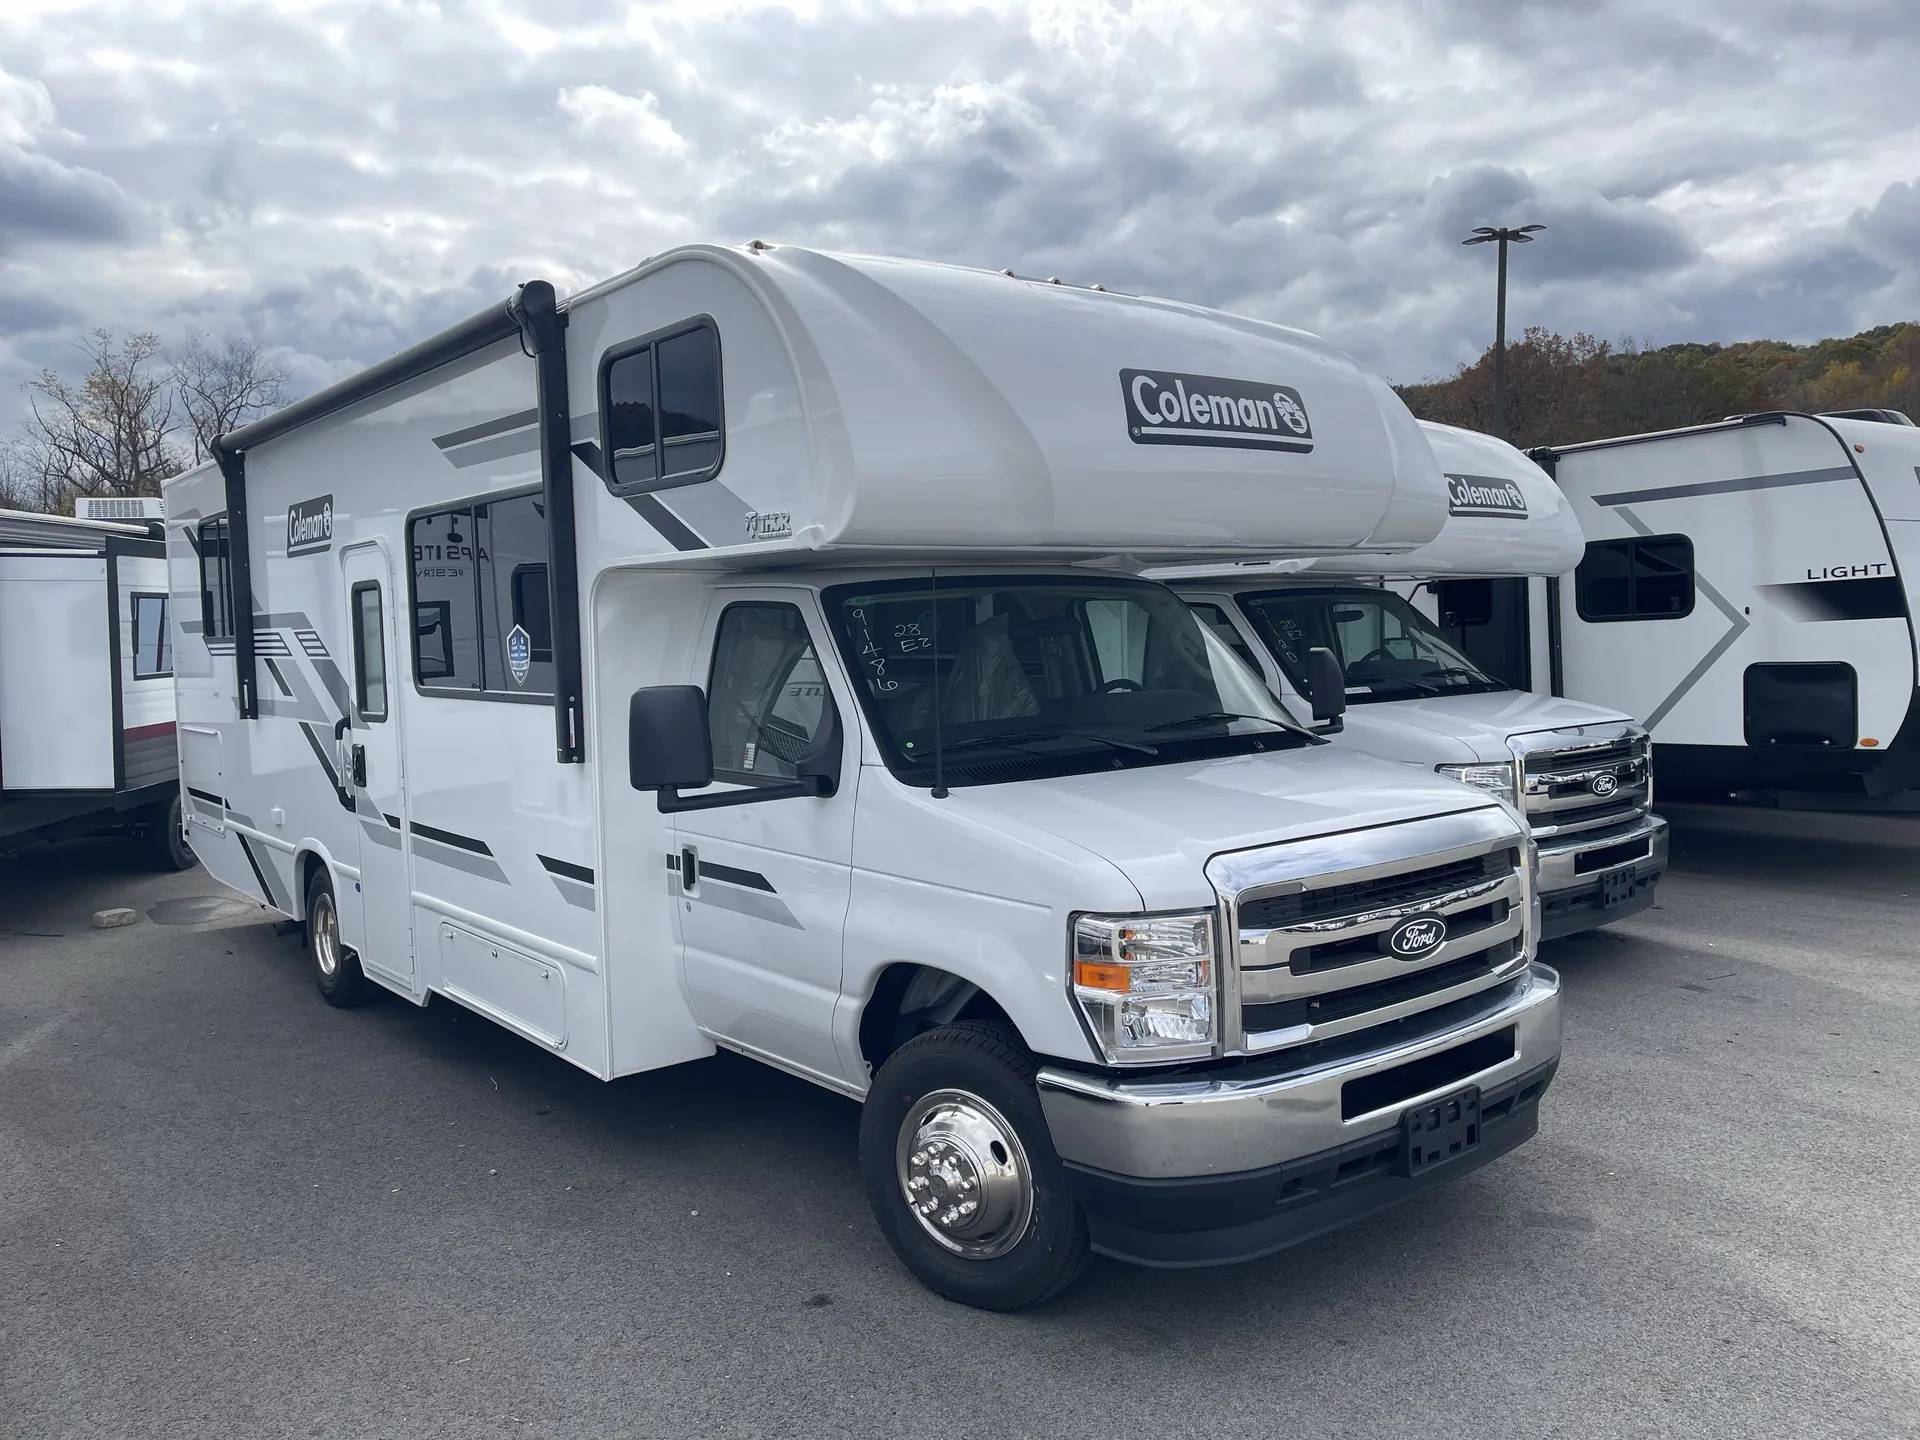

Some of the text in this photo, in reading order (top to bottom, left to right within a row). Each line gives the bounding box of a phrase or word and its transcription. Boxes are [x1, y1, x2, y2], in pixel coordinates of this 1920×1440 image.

[1131, 375, 1278, 430] Coleman
[1444, 476, 1512, 507] Coleman
[290, 508, 323, 545] Coleman
[758, 511, 792, 533] THOR
[1807, 563, 1887, 580] LIGHT
[894, 623, 921, 637] 28
[1597, 777, 1614, 791] Ford
[1402, 923, 1436, 950] Ford
